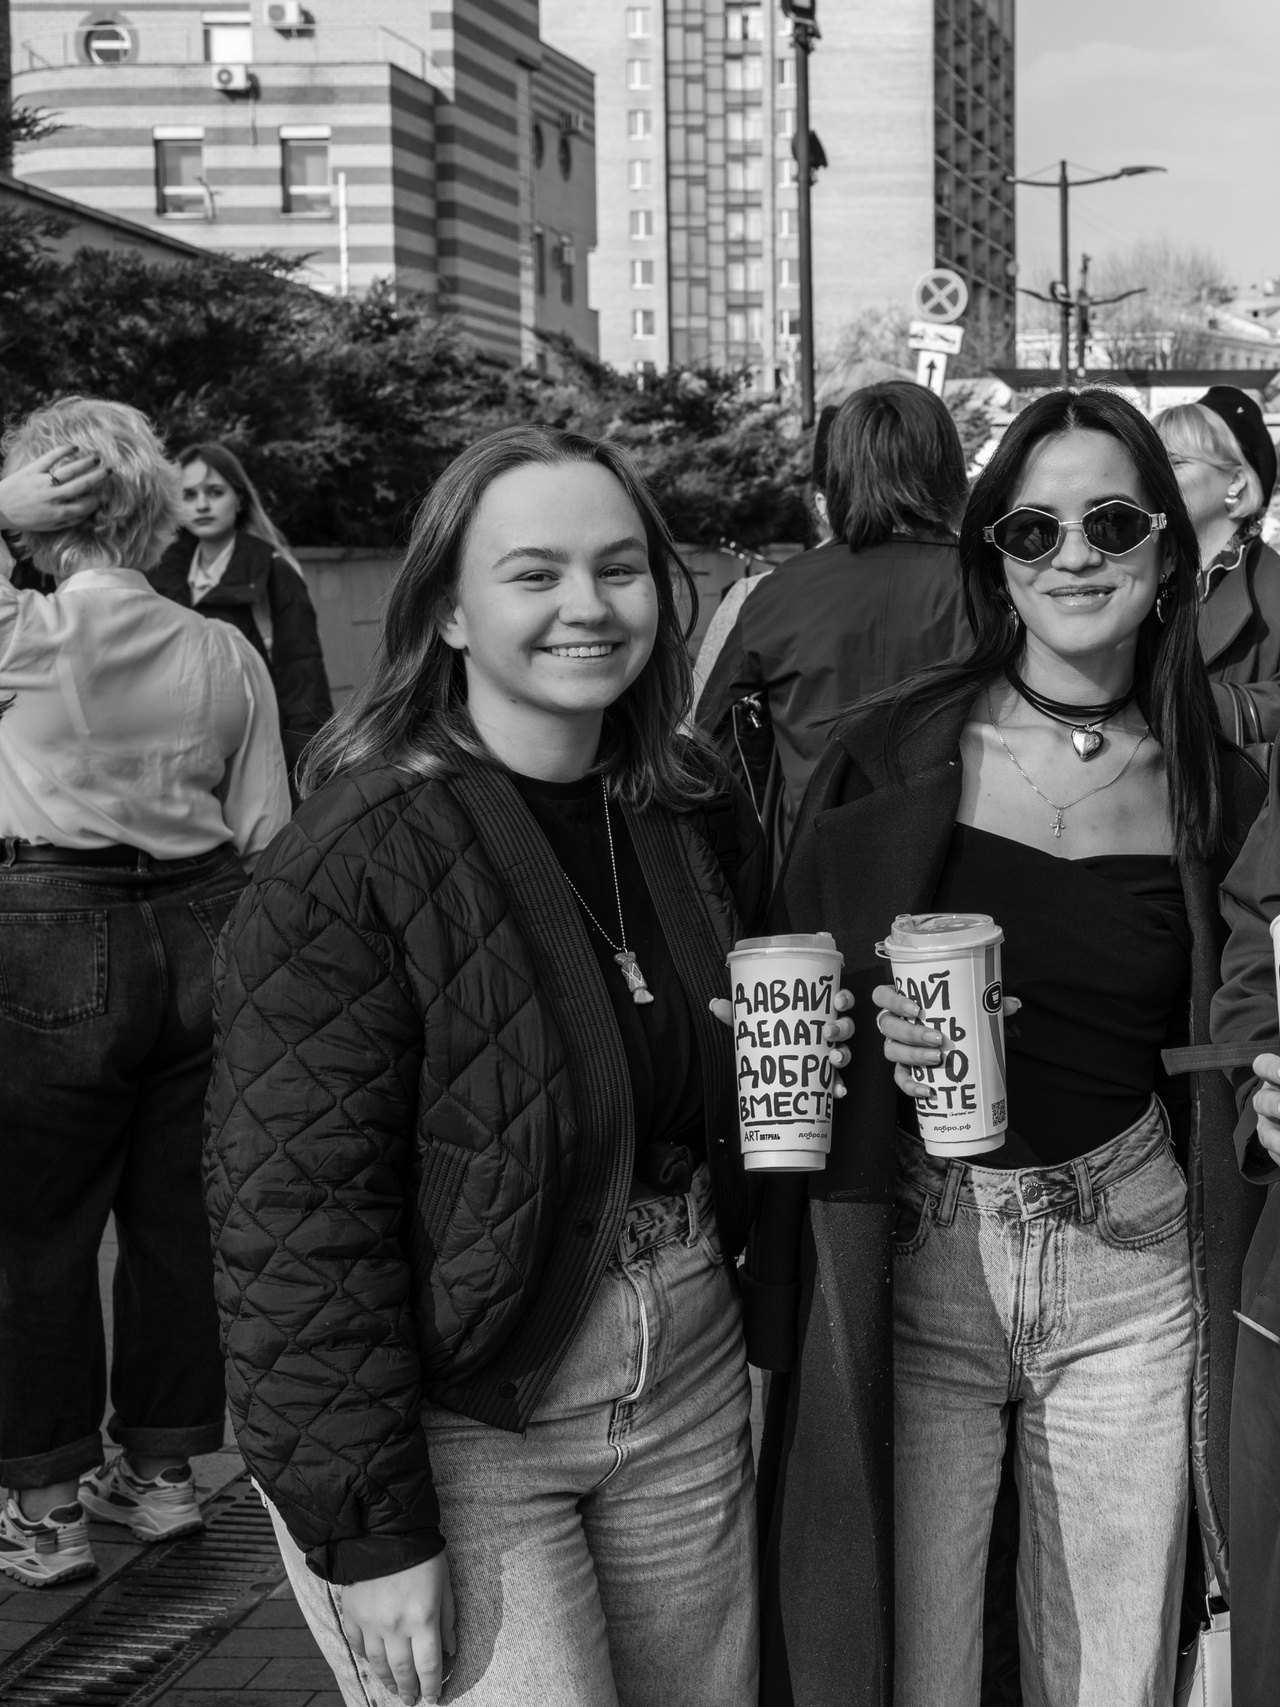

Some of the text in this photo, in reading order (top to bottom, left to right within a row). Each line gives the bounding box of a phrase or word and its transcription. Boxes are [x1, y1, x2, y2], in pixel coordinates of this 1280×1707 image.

[734, 974, 834, 1019] ДАВАЙ
[736, 1019, 833, 1051] ДЕЛАТ
[737, 1054, 832, 1091] ДОБРО
[740, 1091, 833, 1122] ВМЕСТЕ
[934, 1123, 971, 1133] добро.рф
